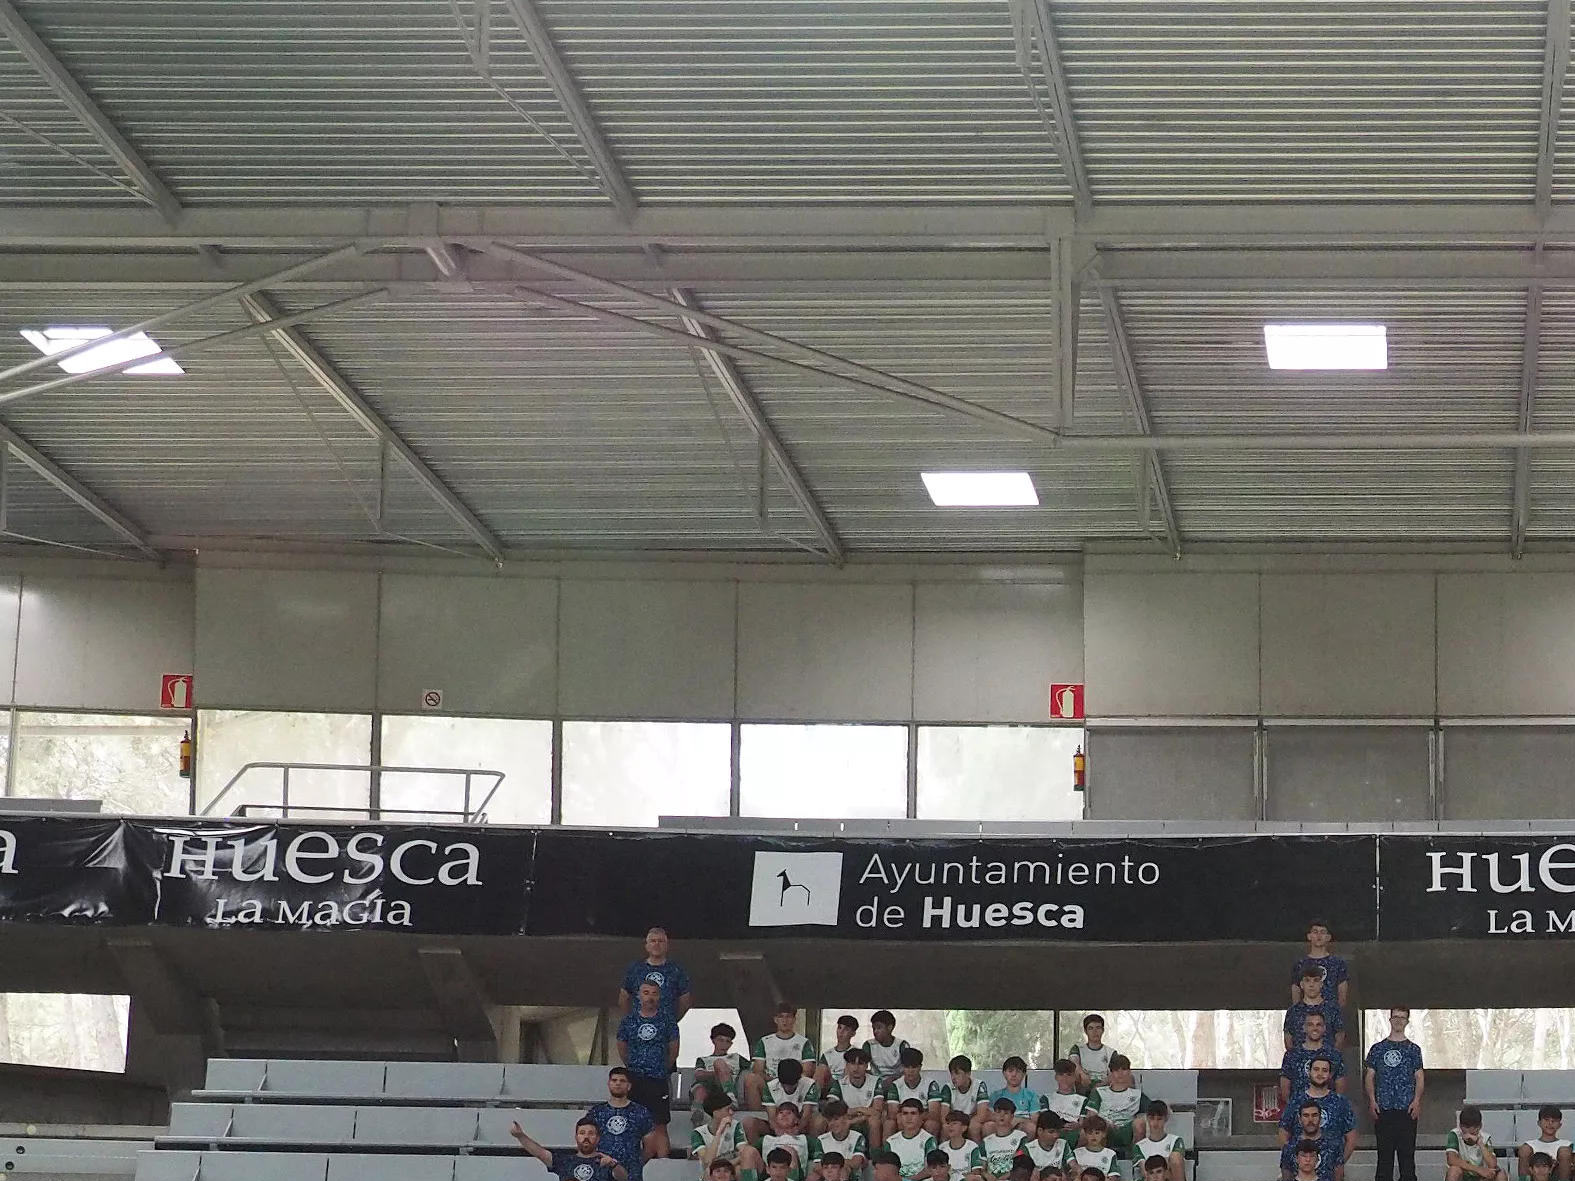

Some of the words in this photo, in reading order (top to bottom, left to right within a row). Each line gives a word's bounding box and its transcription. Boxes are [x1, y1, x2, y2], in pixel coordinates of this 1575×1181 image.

[162, 830, 483, 886] Huesca
[858, 853, 1161, 892] Ayuntamiento
[855, 896, 905, 929] de
[922, 896, 1085, 930] Huesca
